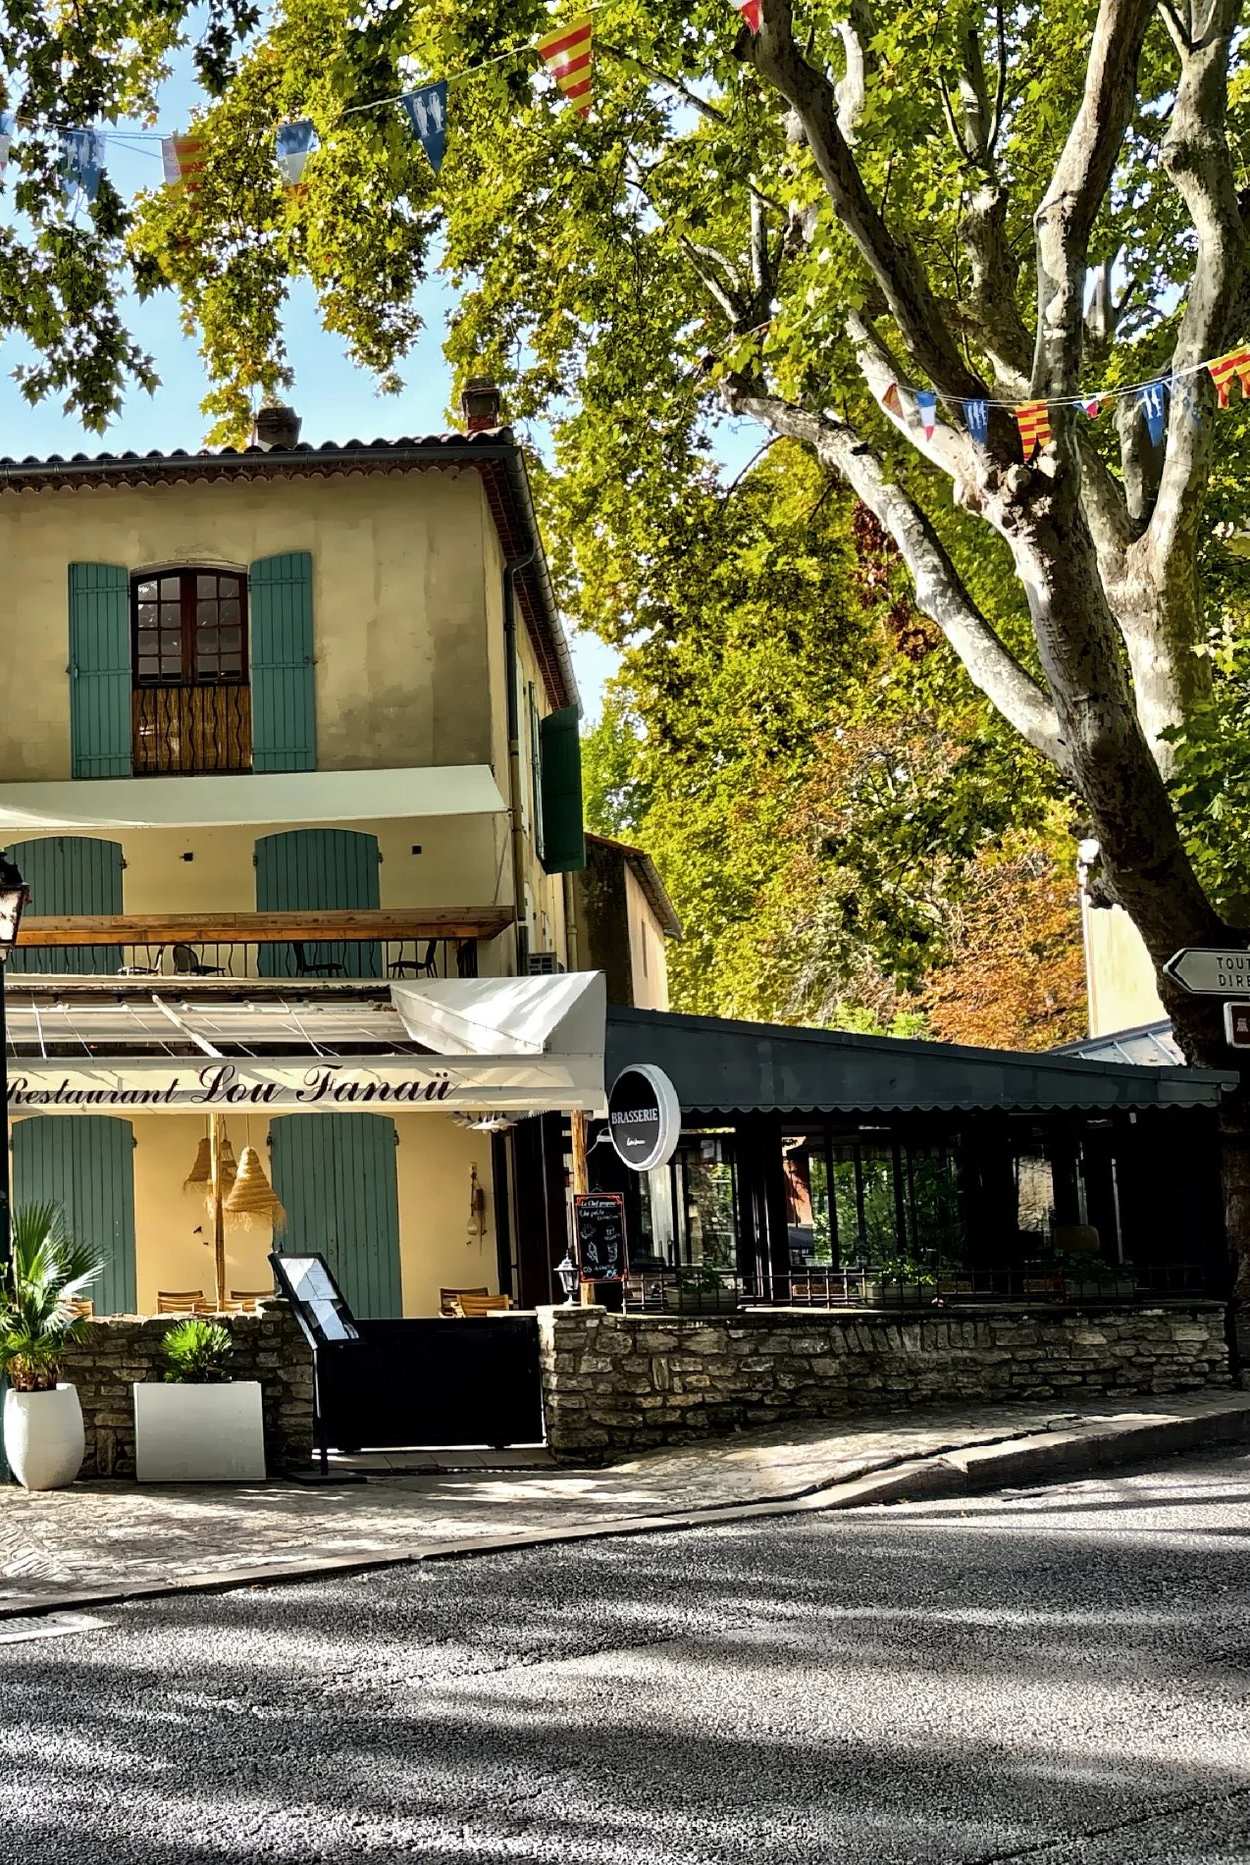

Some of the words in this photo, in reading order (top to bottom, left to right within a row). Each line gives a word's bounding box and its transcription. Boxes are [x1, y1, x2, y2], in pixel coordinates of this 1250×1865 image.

[191, 1064, 286, 1104] Lou
[295, 1064, 461, 1104] Fanaü
[611, 1108, 658, 1125] BRASSERIE
